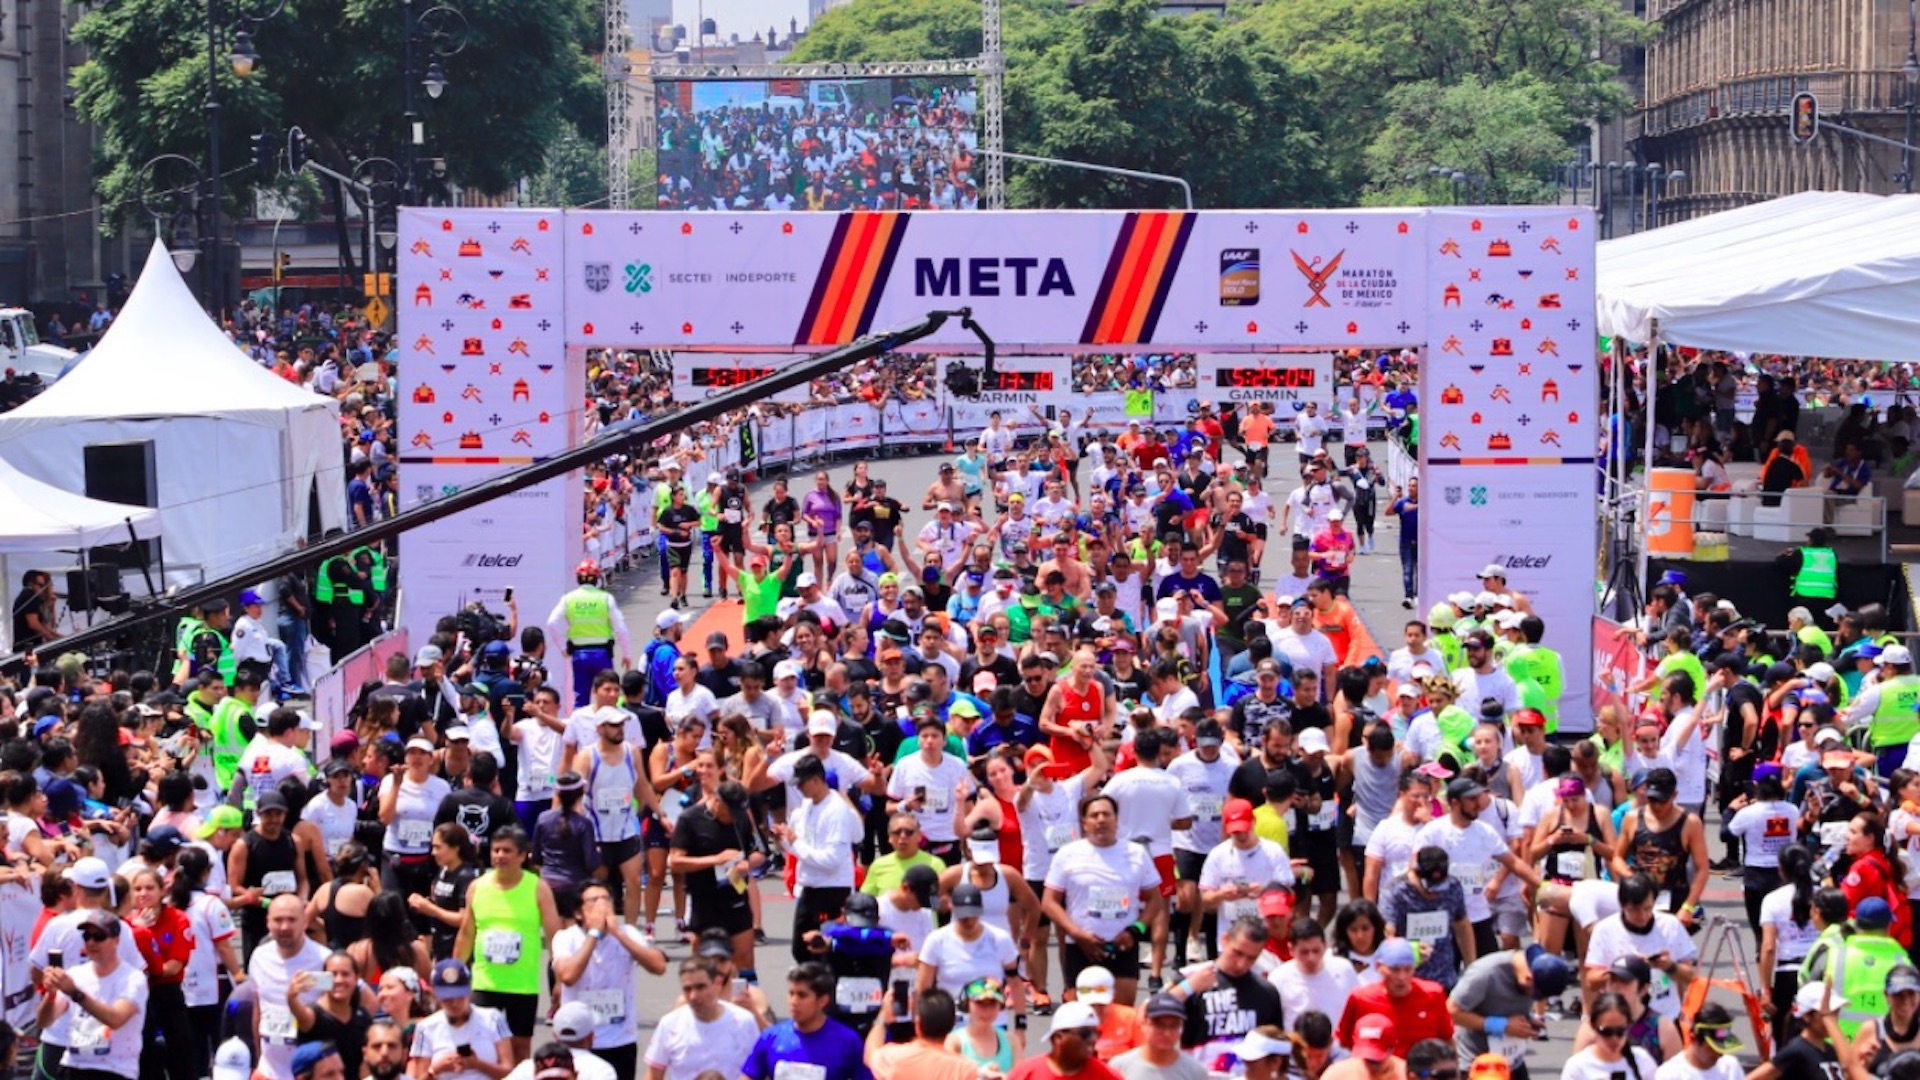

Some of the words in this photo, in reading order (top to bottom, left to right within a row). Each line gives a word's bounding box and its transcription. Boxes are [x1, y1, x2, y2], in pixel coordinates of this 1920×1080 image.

[669, 273, 712, 283] SECTEI
[725, 272, 797, 283] INDEPORTE
[915, 257, 1075, 297] META
[1336, 280, 1346, 288] DE
[1349, 280, 1359, 288] LA
[1361, 279, 1398, 288] CIUDAD
[1342, 289, 1354, 299] DE
[1232, 367, 1313, 388] 5:25:04
[1229, 389, 1298, 400] GARMIN
[477, 554, 523, 567] telcel
[1506, 555, 1551, 568] telcel
[1203, 988, 1238, 1013] THE
[1860, 994, 1877, 1007] 14
[1203, 1009, 1257, 1036] TEAM
